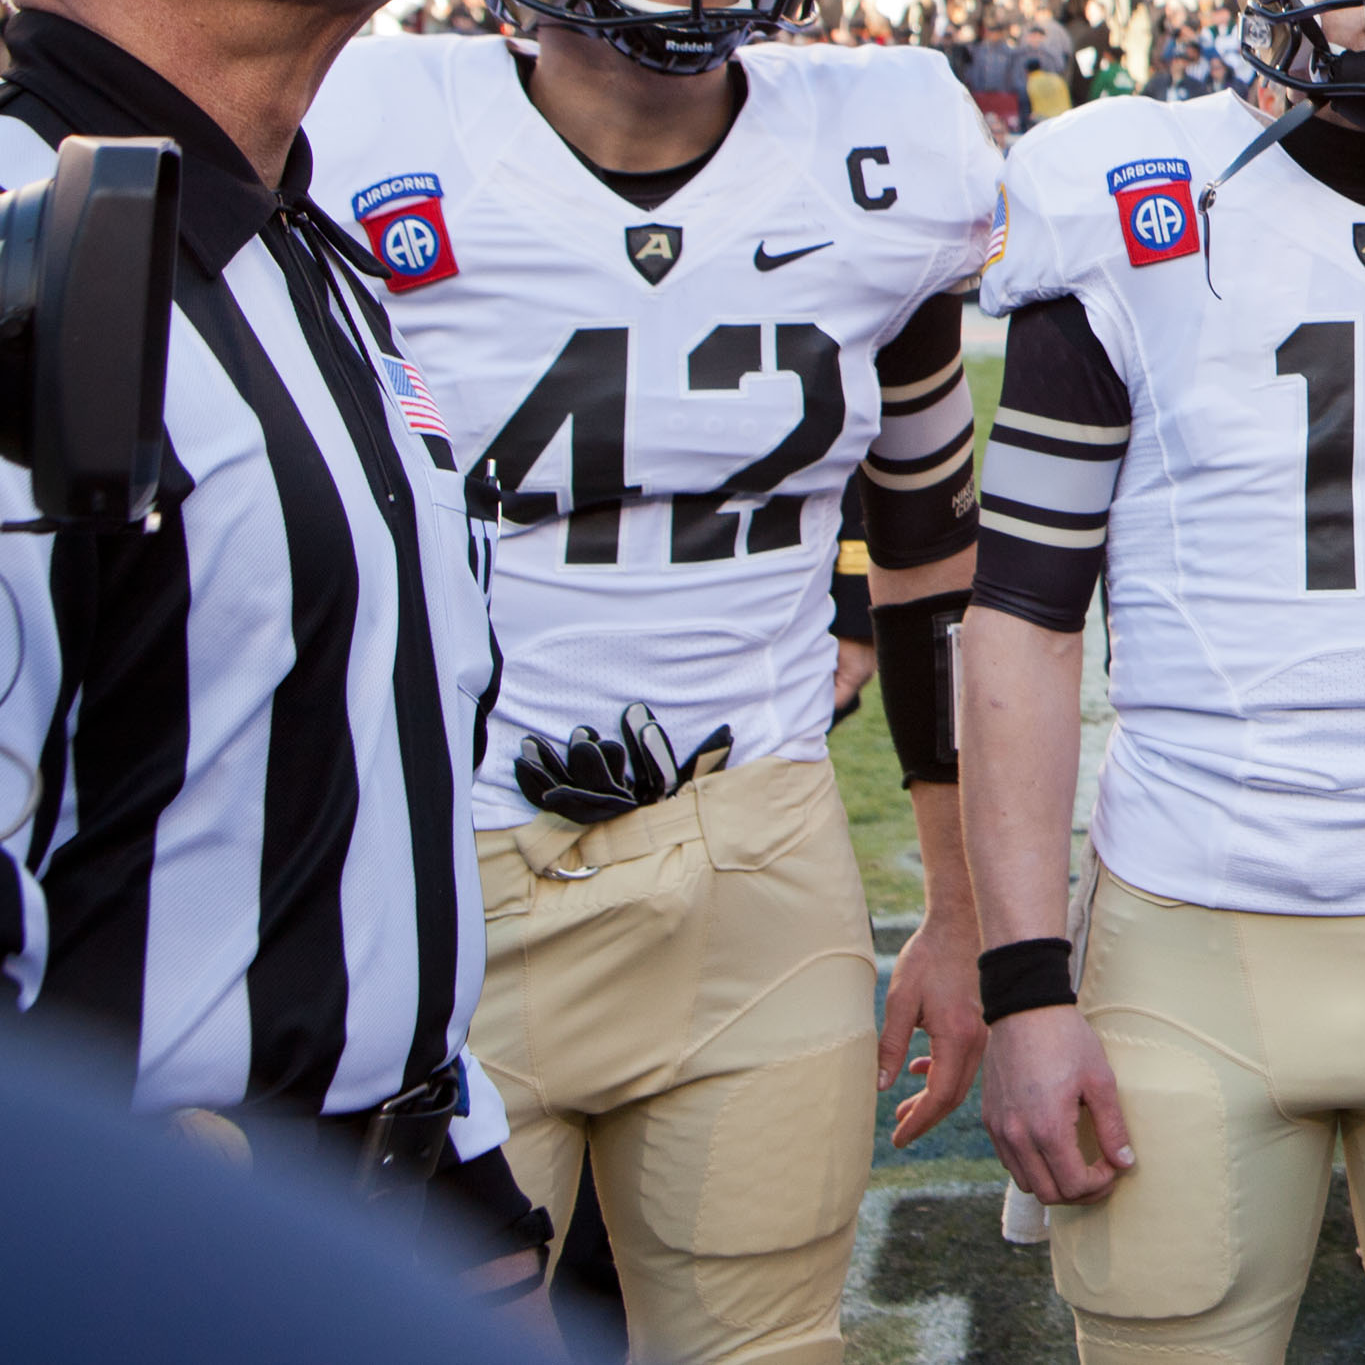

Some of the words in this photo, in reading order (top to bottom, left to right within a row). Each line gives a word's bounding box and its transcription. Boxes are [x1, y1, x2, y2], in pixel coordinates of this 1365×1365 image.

[666, 39, 713, 53] Riddell
[357, 175, 437, 213] AIRBORNE
[847, 146, 898, 211] C
[1113, 162, 1187, 187] AIRBORNE
[1136, 198, 1183, 244] AA
[385, 218, 435, 269] AA
[635, 233, 673, 259] A
[460, 320, 847, 565] 42
